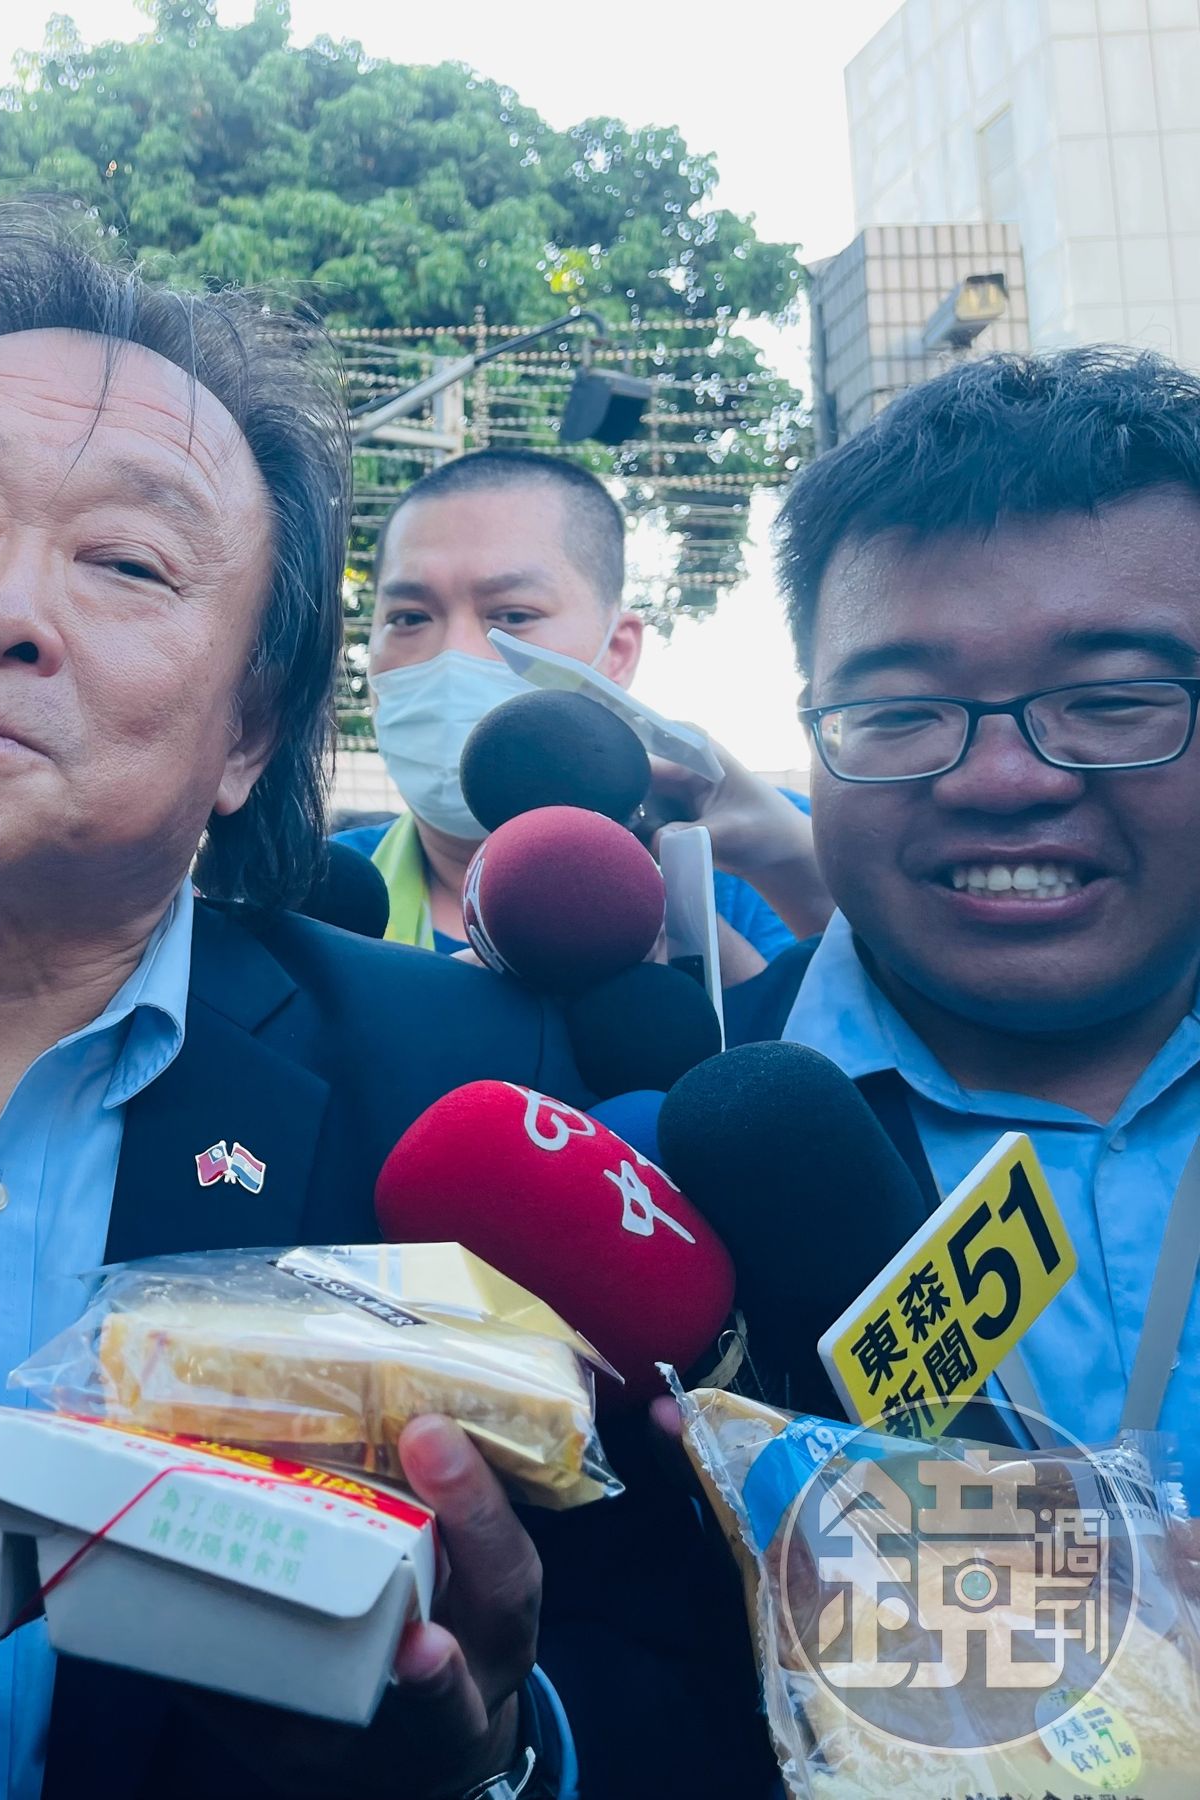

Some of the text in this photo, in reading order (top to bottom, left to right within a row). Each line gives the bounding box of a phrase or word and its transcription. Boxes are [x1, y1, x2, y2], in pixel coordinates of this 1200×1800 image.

[947, 1160, 1061, 1340] 51
[850, 1260, 951, 1396] 東森
[881, 1319, 978, 1438] 新聞
[805, 1426, 839, 1463] 49
